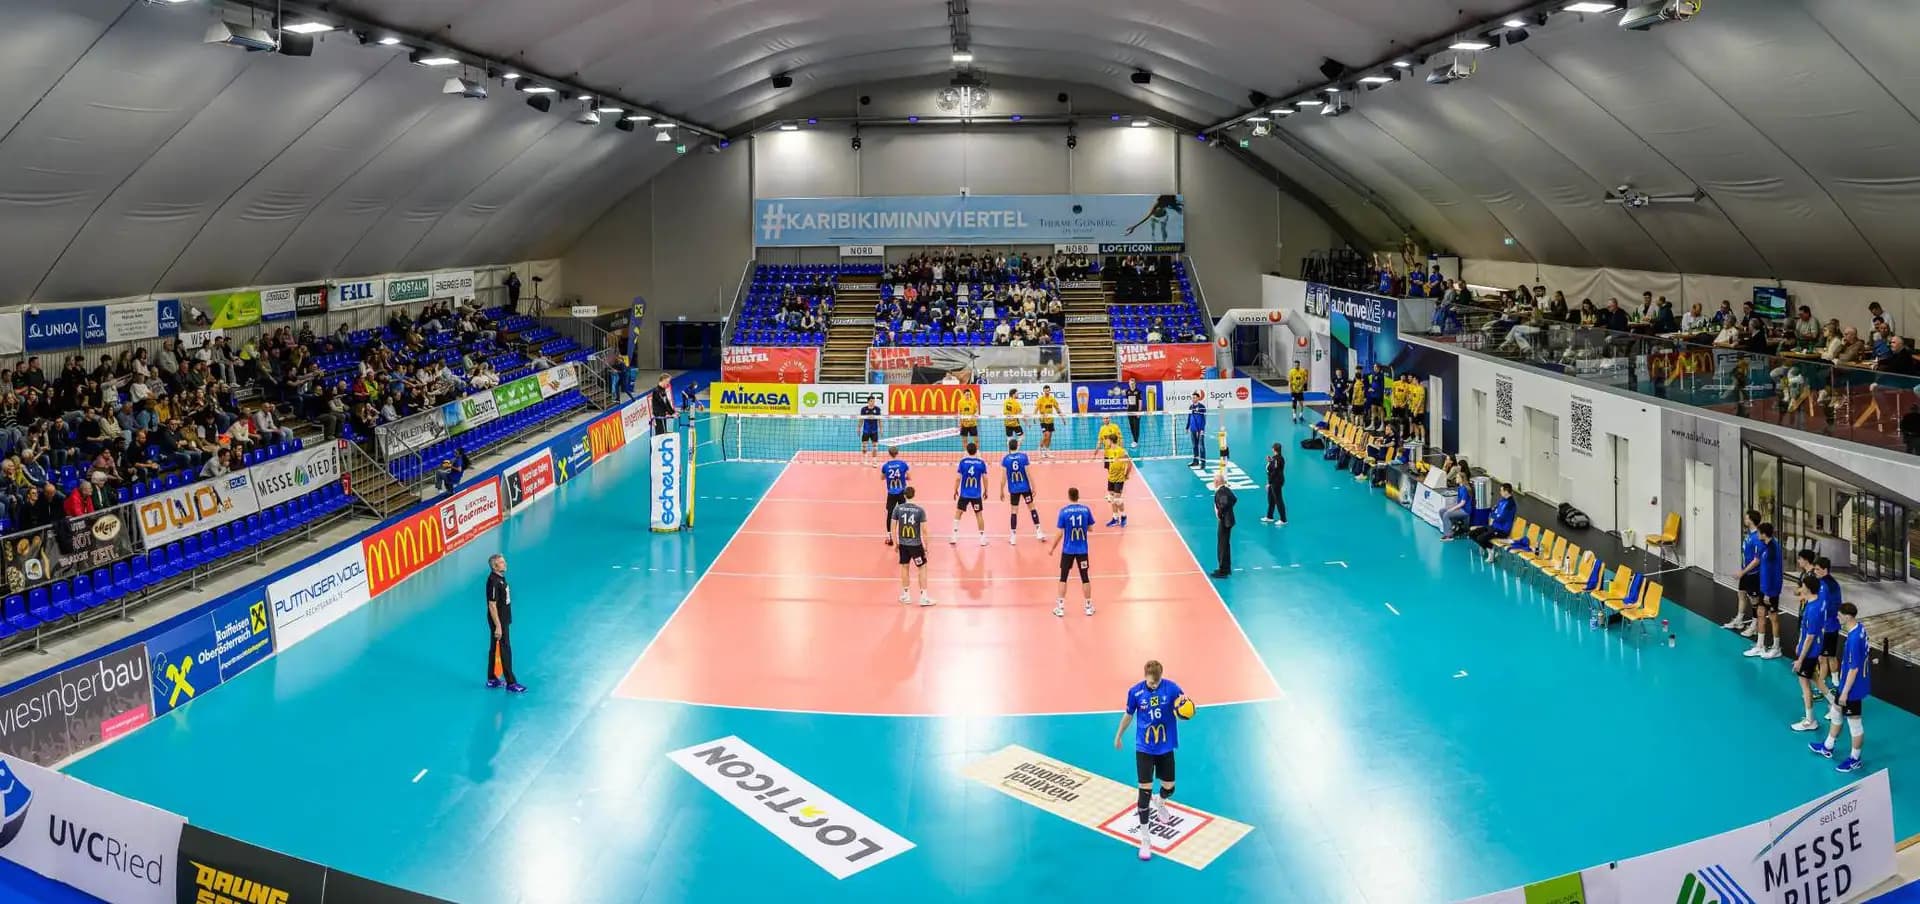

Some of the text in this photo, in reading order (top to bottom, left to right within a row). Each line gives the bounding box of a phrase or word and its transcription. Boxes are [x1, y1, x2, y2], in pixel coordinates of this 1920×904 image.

[762, 203, 1029, 240] #KARIBIKIMINNVIERTEL
[850, 247, 873, 255] NORD
[1065, 245, 1089, 254] NORD
[396, 280, 428, 293] POSTALM
[45, 321, 79, 336] UNIQA
[160, 320, 178, 330] UNIQA
[85, 328, 105, 340] UNIQA
[190, 331, 212, 346] WEST
[723, 353, 769, 364] VIERTEL
[871, 355, 934, 370] VIERTEL
[1120, 350, 1166, 363] VIERTEL
[1003, 368, 1038, 377] stehst
[1041, 368, 1055, 377] du
[822, 392, 884, 404] MAIER
[1210, 390, 1233, 400] Sport
[1094, 398, 1121, 406] RIEDER
[968, 466, 975, 476] 4
[1012, 460, 1019, 470] 6
[257, 472, 294, 497] MESSE
[307, 459, 330, 480] RIED
[888, 468, 900, 478] 24
[902, 513, 916, 525] 14
[1070, 514, 1083, 527] 11
[216, 618, 250, 641] Raiffeisen
[198, 627, 252, 665] Oberösterreich
[1148, 708, 1162, 720] 16
[1014, 762, 1083, 790] regional
[1004, 771, 1081, 802] maximal
[1820, 800, 1858, 826] seit 1867
[50, 814, 163, 886] UVCRied
[1764, 819, 1862, 892] MESSE
